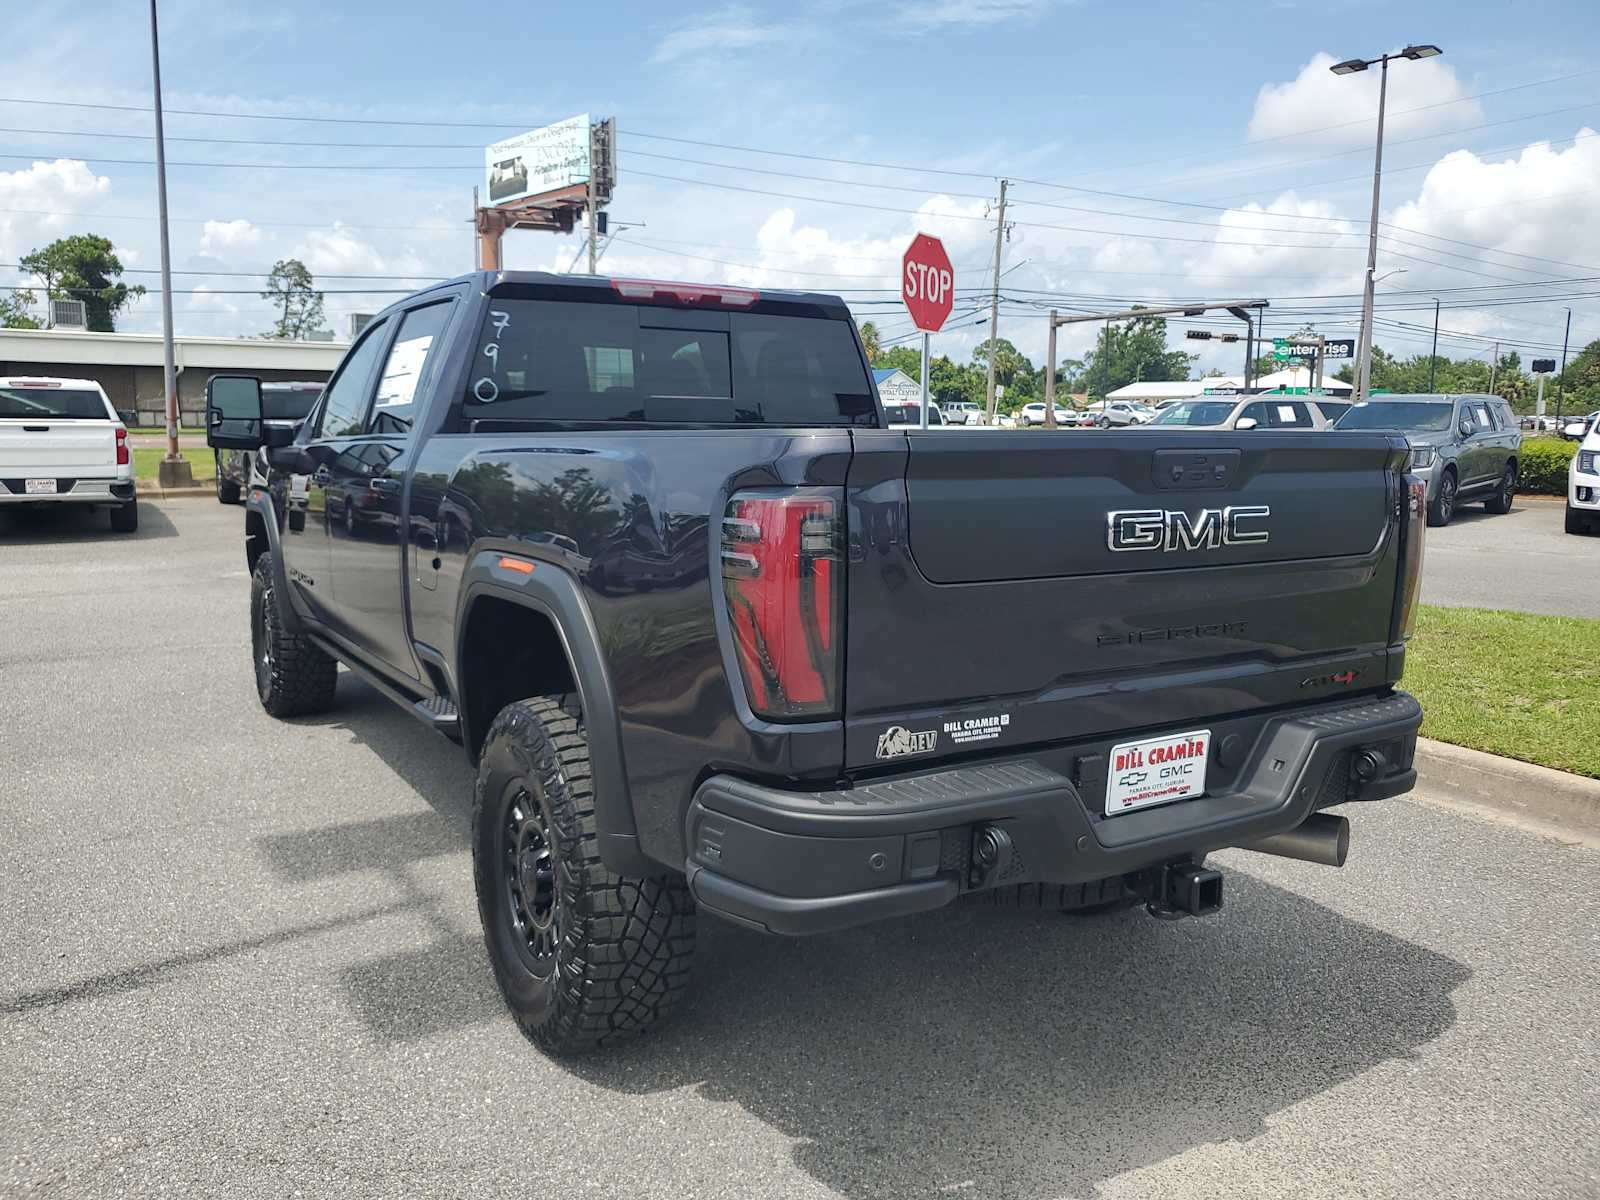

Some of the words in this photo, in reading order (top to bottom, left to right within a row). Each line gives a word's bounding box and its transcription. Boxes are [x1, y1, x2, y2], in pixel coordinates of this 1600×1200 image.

[905, 260, 951, 304] STOP
[1279, 343, 1349, 357] enterprise
[1107, 505, 1270, 552] GMC
[943, 722, 962, 732] BILL
[964, 717, 1000, 729] CRAMER
[910, 732, 936, 752] AEV
[1115, 752, 1144, 772] BILL
[1148, 741, 1204, 765] CRAMER
[1160, 763, 1194, 778] GMC
